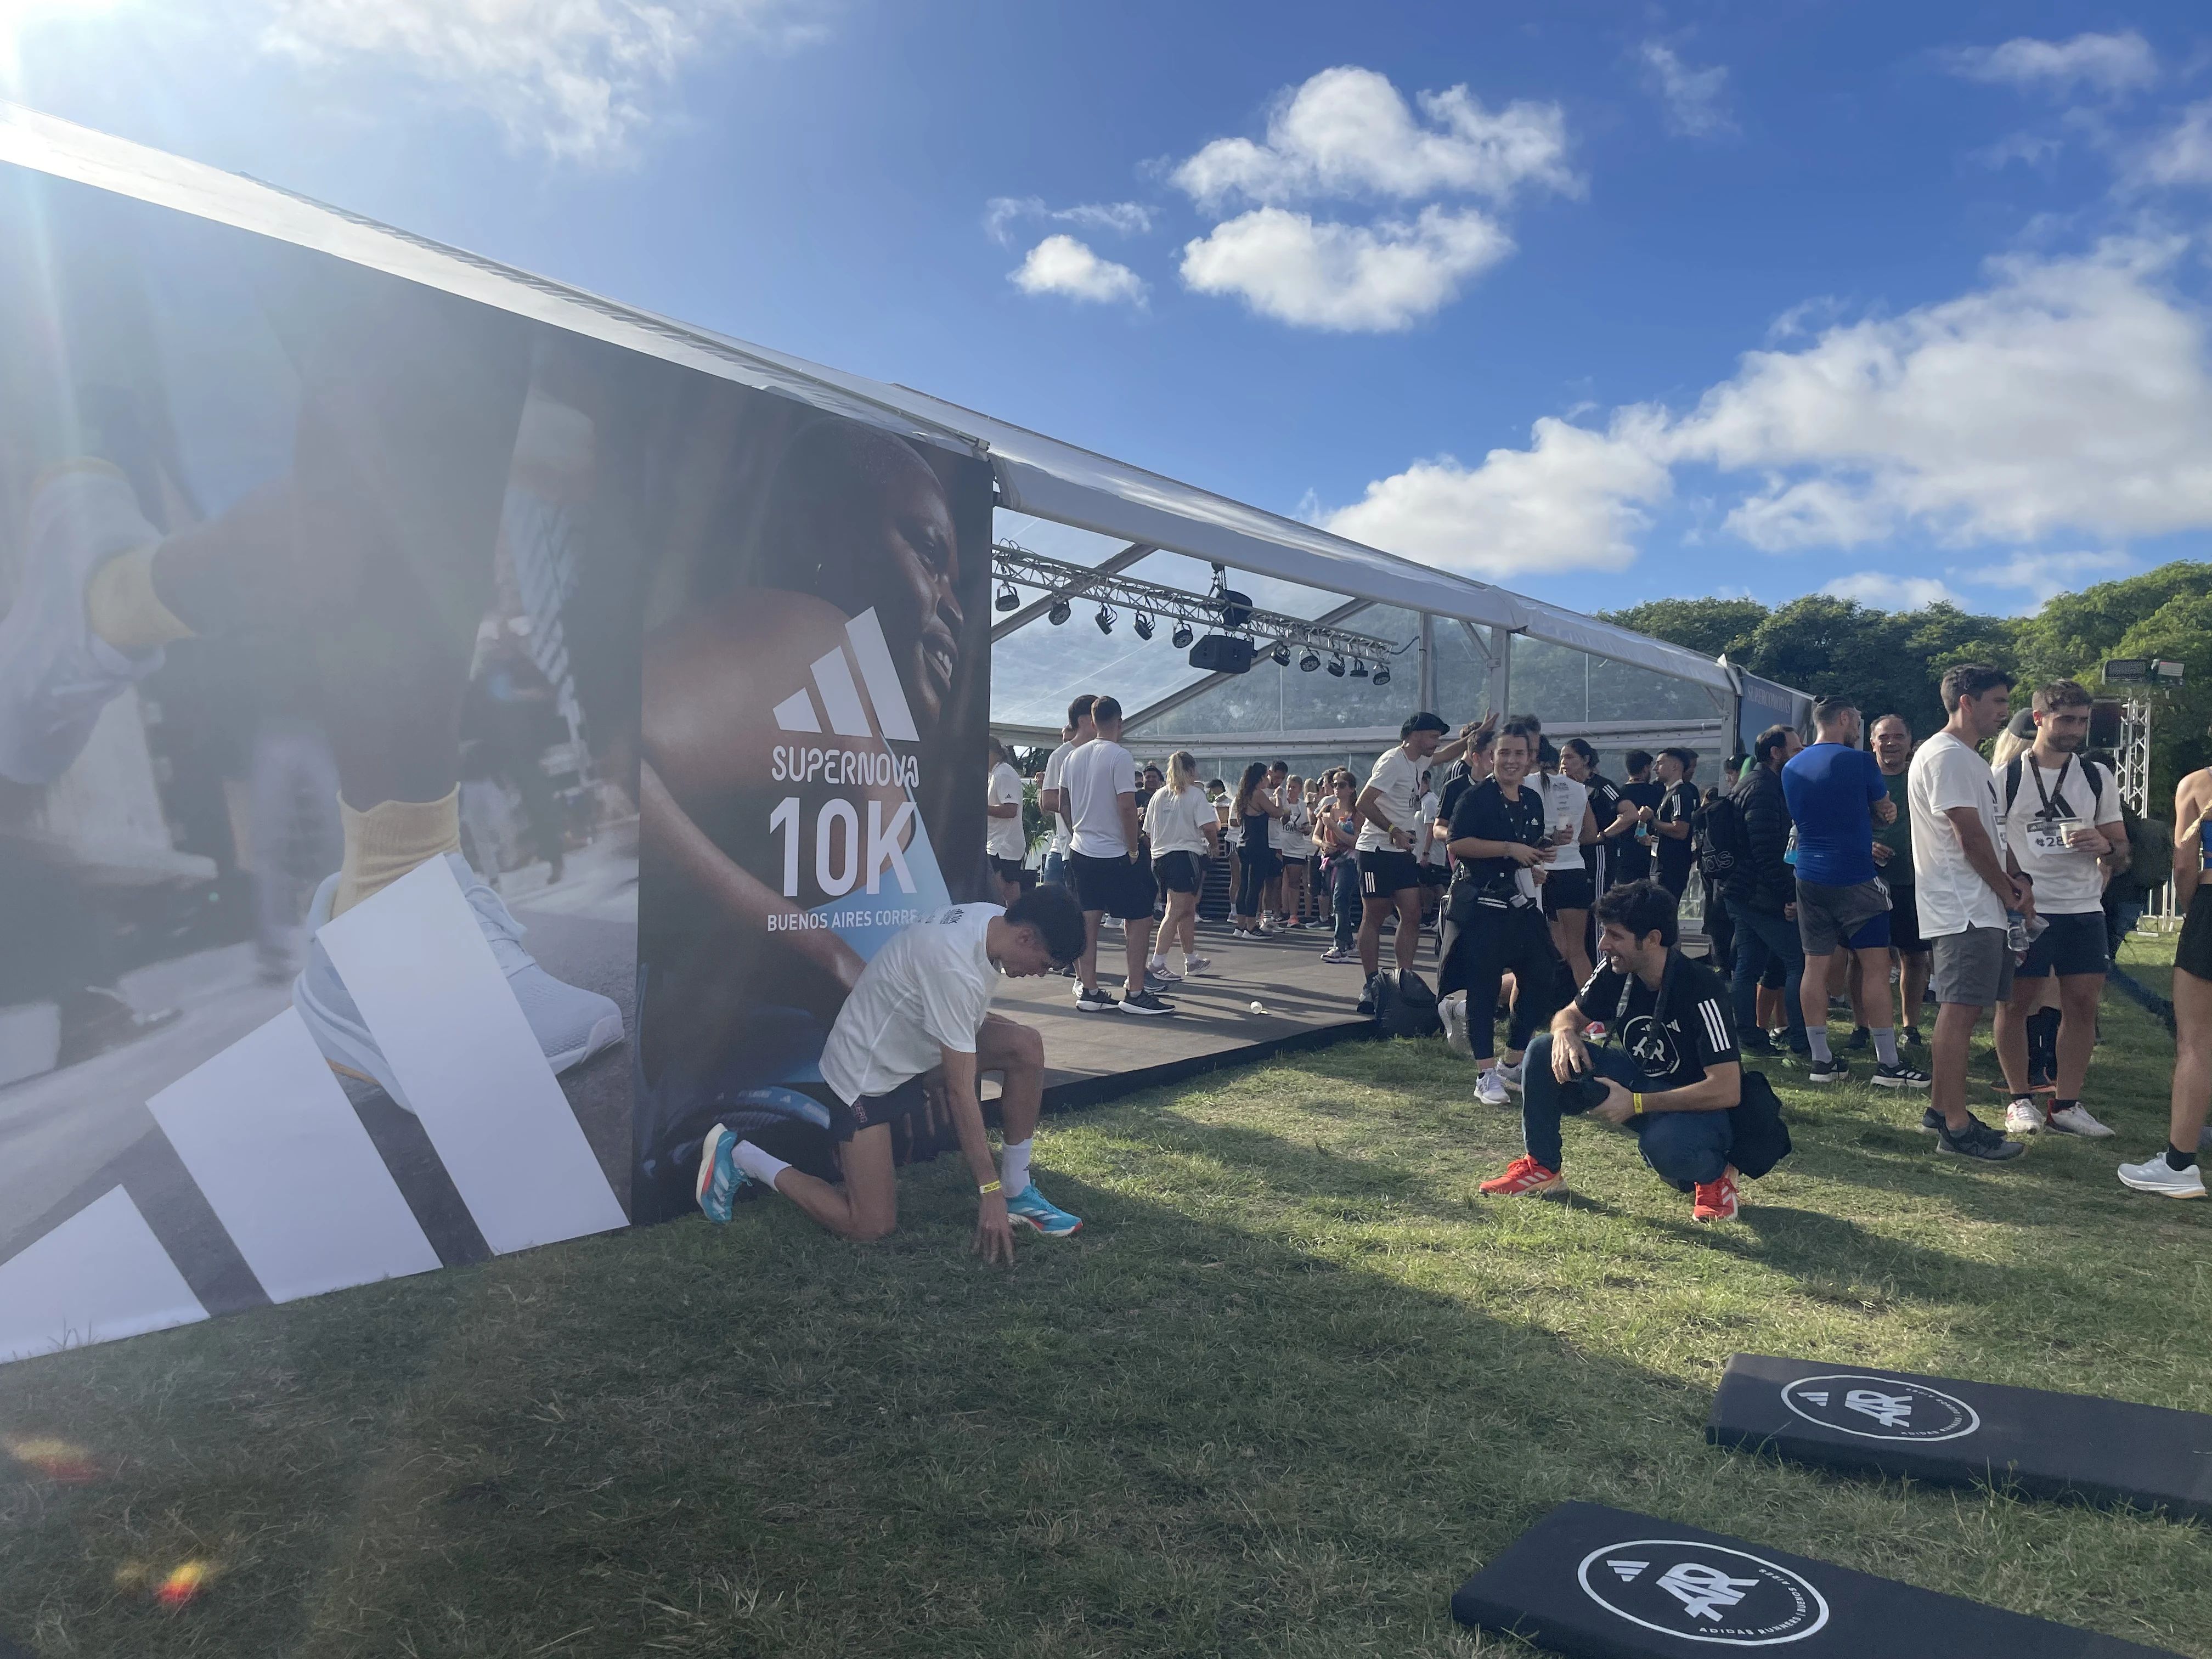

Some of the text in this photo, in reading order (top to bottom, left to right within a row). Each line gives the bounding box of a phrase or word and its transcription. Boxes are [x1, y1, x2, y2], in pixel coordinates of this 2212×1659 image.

[771, 745, 920, 788] SUPERNOVA
[769, 797, 918, 898] 10K
[768, 912, 827, 932] BUENOS
[831, 911, 872, 928] AIRES
[1757, 1616, 1802, 1635] RUNNERS
